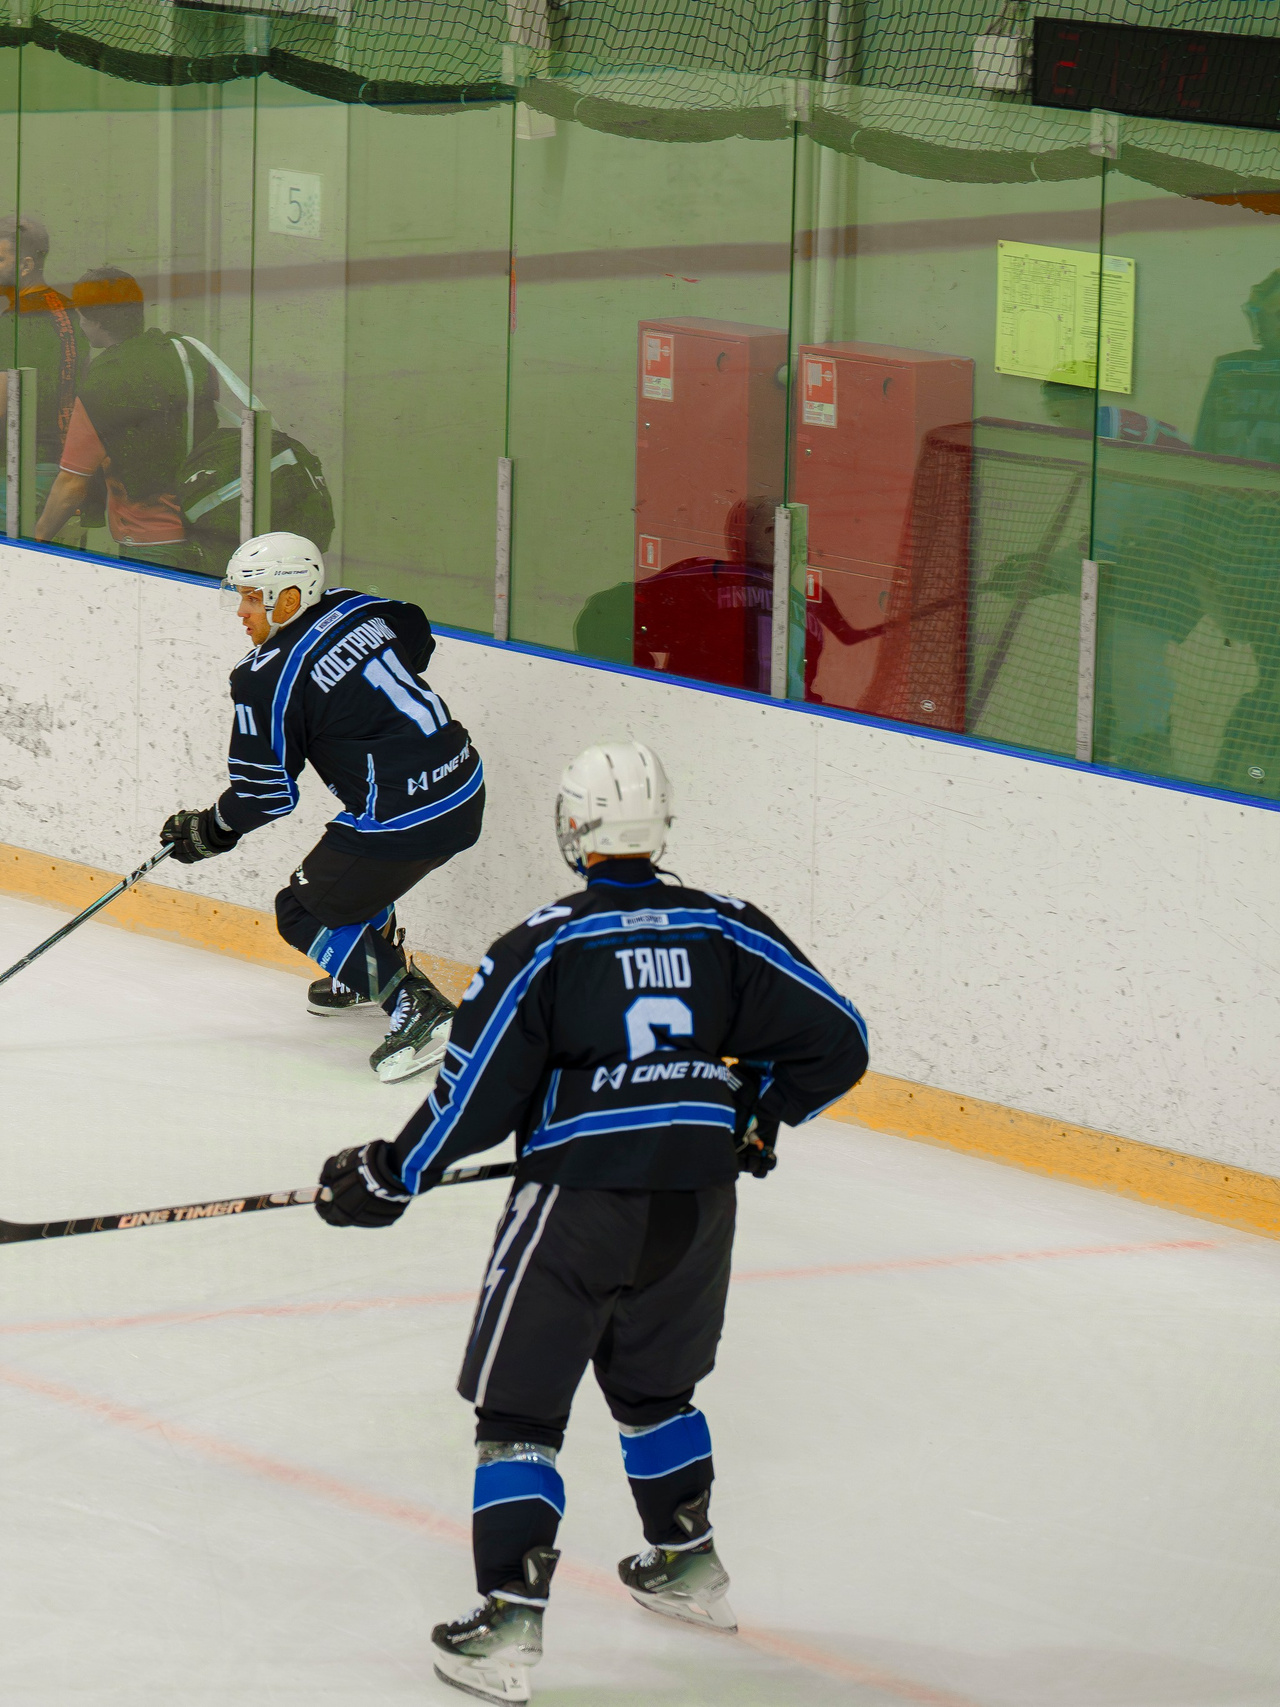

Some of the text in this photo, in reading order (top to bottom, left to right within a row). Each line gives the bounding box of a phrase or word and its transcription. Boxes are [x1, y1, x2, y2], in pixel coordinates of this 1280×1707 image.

[286, 186, 301, 224] 5
[361, 647, 449, 738] 11
[235, 703, 258, 736] 11
[432, 755, 459, 783] ONE
[631, 1062, 690, 1083] ONE
[117, 1200, 246, 1229] ONE TIMER
